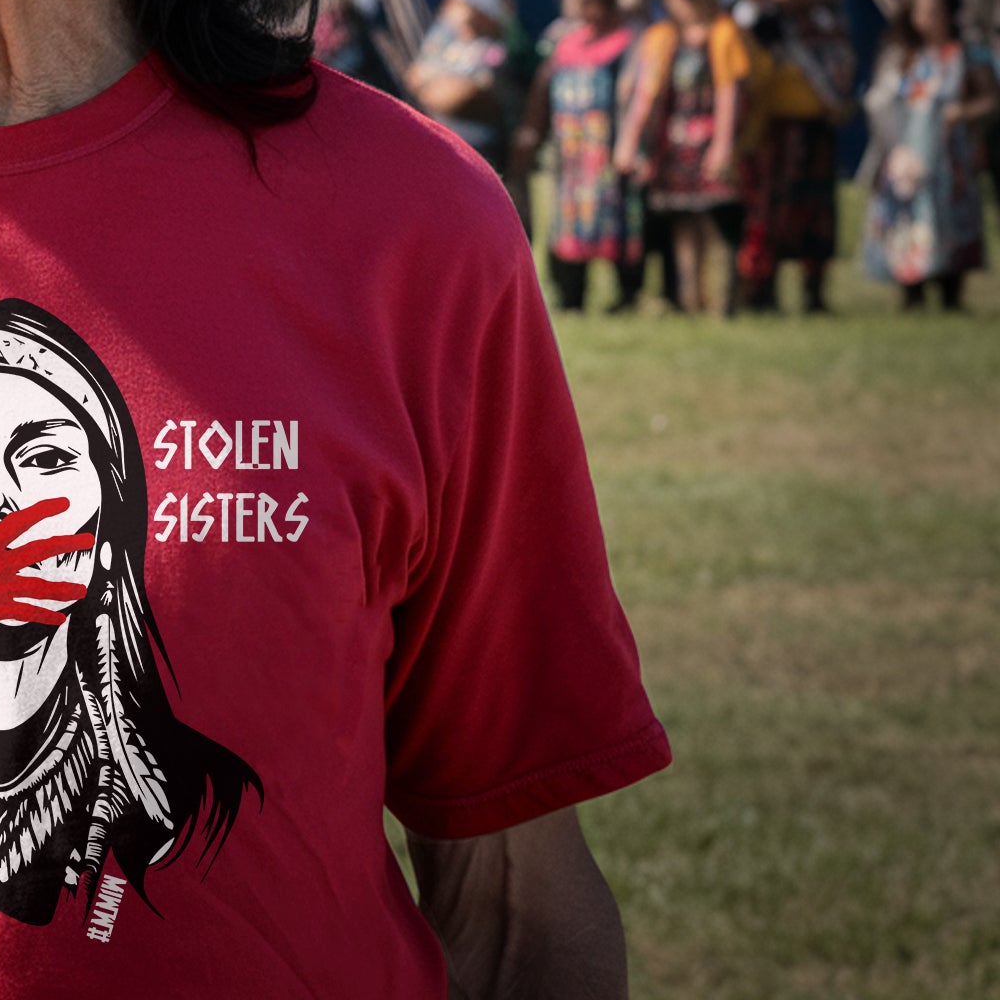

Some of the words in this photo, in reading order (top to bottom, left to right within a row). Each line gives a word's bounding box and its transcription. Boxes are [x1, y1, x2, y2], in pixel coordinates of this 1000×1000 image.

[153, 420, 299, 469] STOLEN
[153, 492, 309, 542] SISTERS
[86, 874, 127, 943] #MMIW
